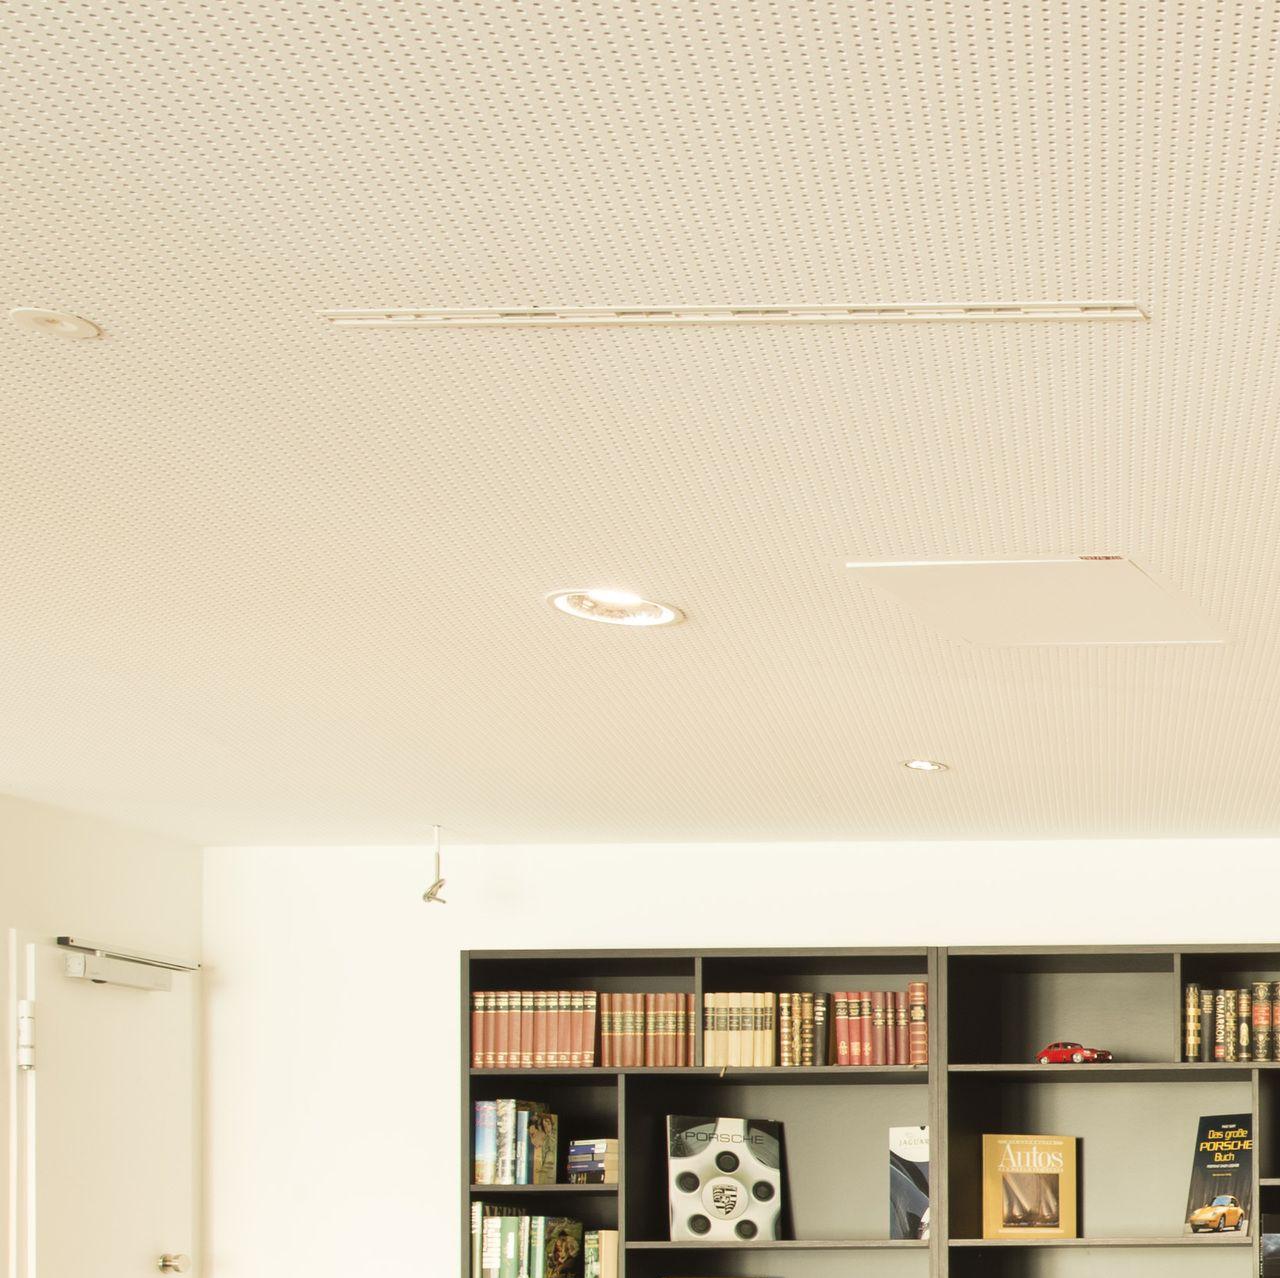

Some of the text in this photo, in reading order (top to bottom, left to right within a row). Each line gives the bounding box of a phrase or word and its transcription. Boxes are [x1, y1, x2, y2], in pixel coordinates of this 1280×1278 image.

[1215, 995, 1225, 1043] CIMARRON
[685, 1131, 764, 1145] PORSCHE
[1208, 1128, 1248, 1140] Das große
[1200, 1140, 1254, 1151] PORSCHE
[998, 1143, 1064, 1168] Autos
[1214, 1152, 1235, 1162] Buch
